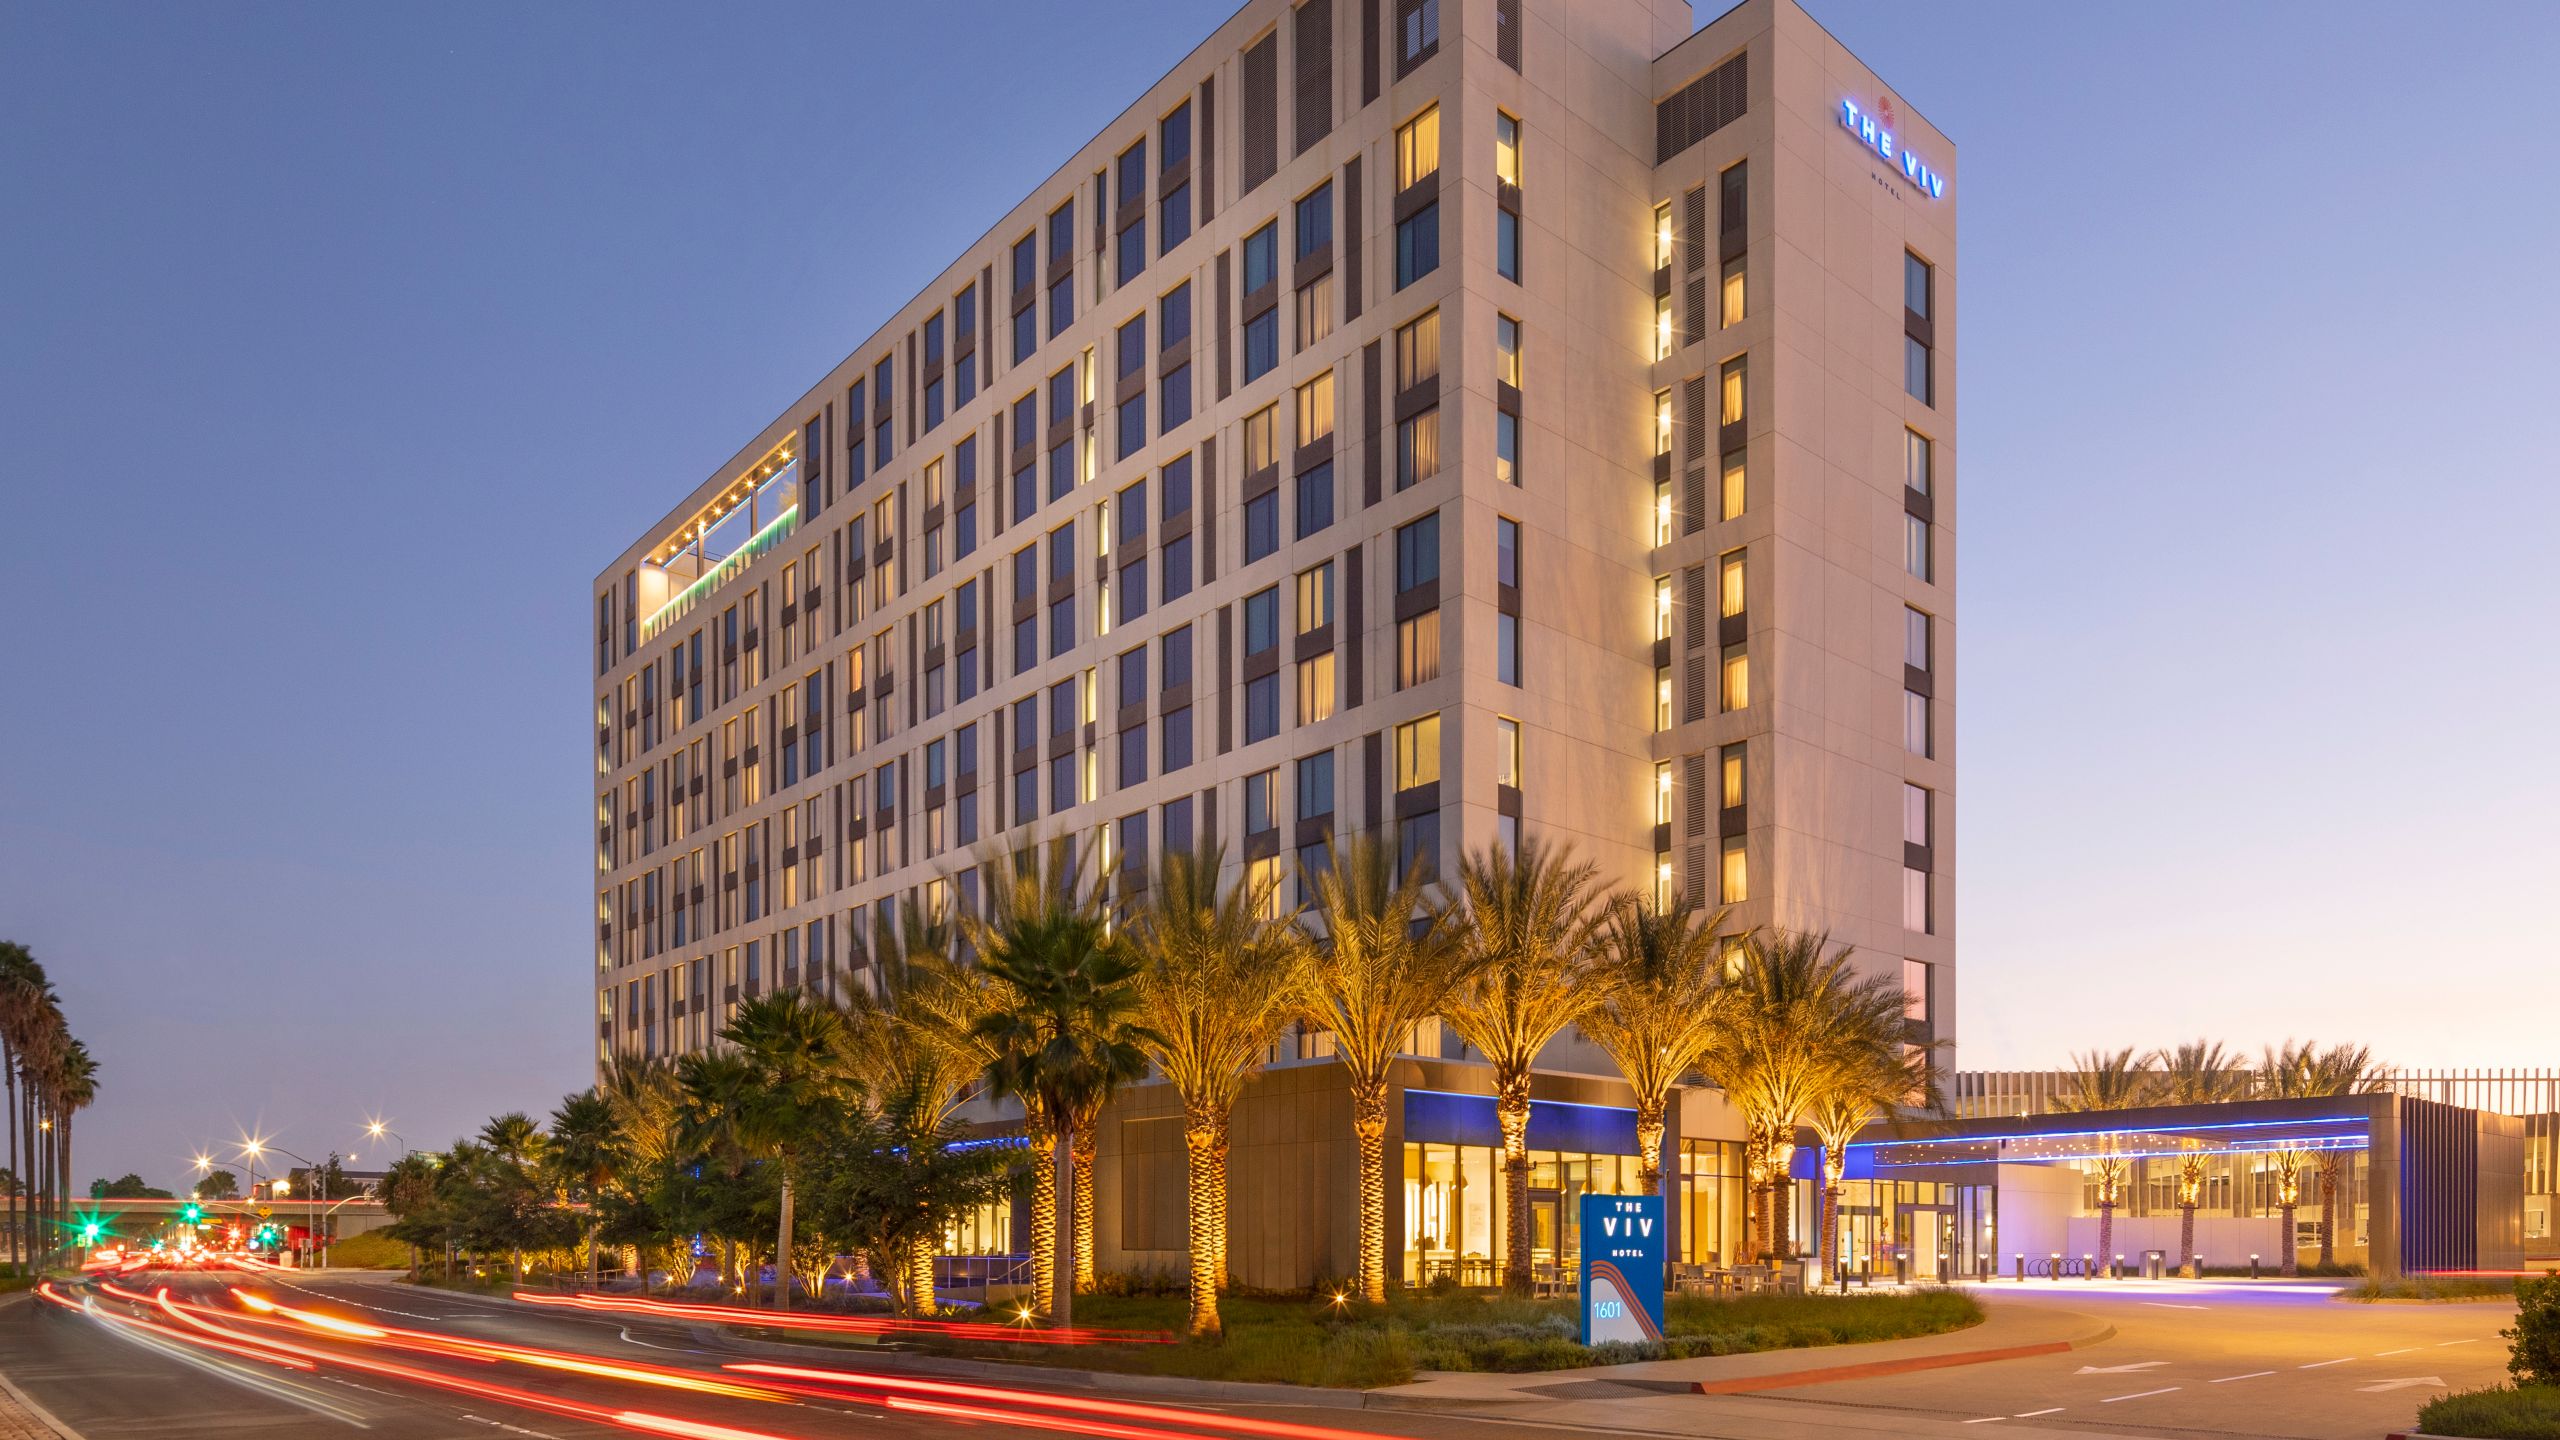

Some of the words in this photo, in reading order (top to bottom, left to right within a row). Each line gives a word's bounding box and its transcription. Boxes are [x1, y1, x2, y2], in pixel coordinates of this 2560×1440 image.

[1843, 100, 1892, 158] THE
[1902, 150, 1943, 198] VIV
[1871, 172, 1901, 200] HOTEL
[1615, 1202, 1642, 1213] THE
[1603, 1217, 1653, 1237] VIV
[1612, 1249, 1644, 1257] HOTEL
[1594, 1301, 1621, 1318] 1601
